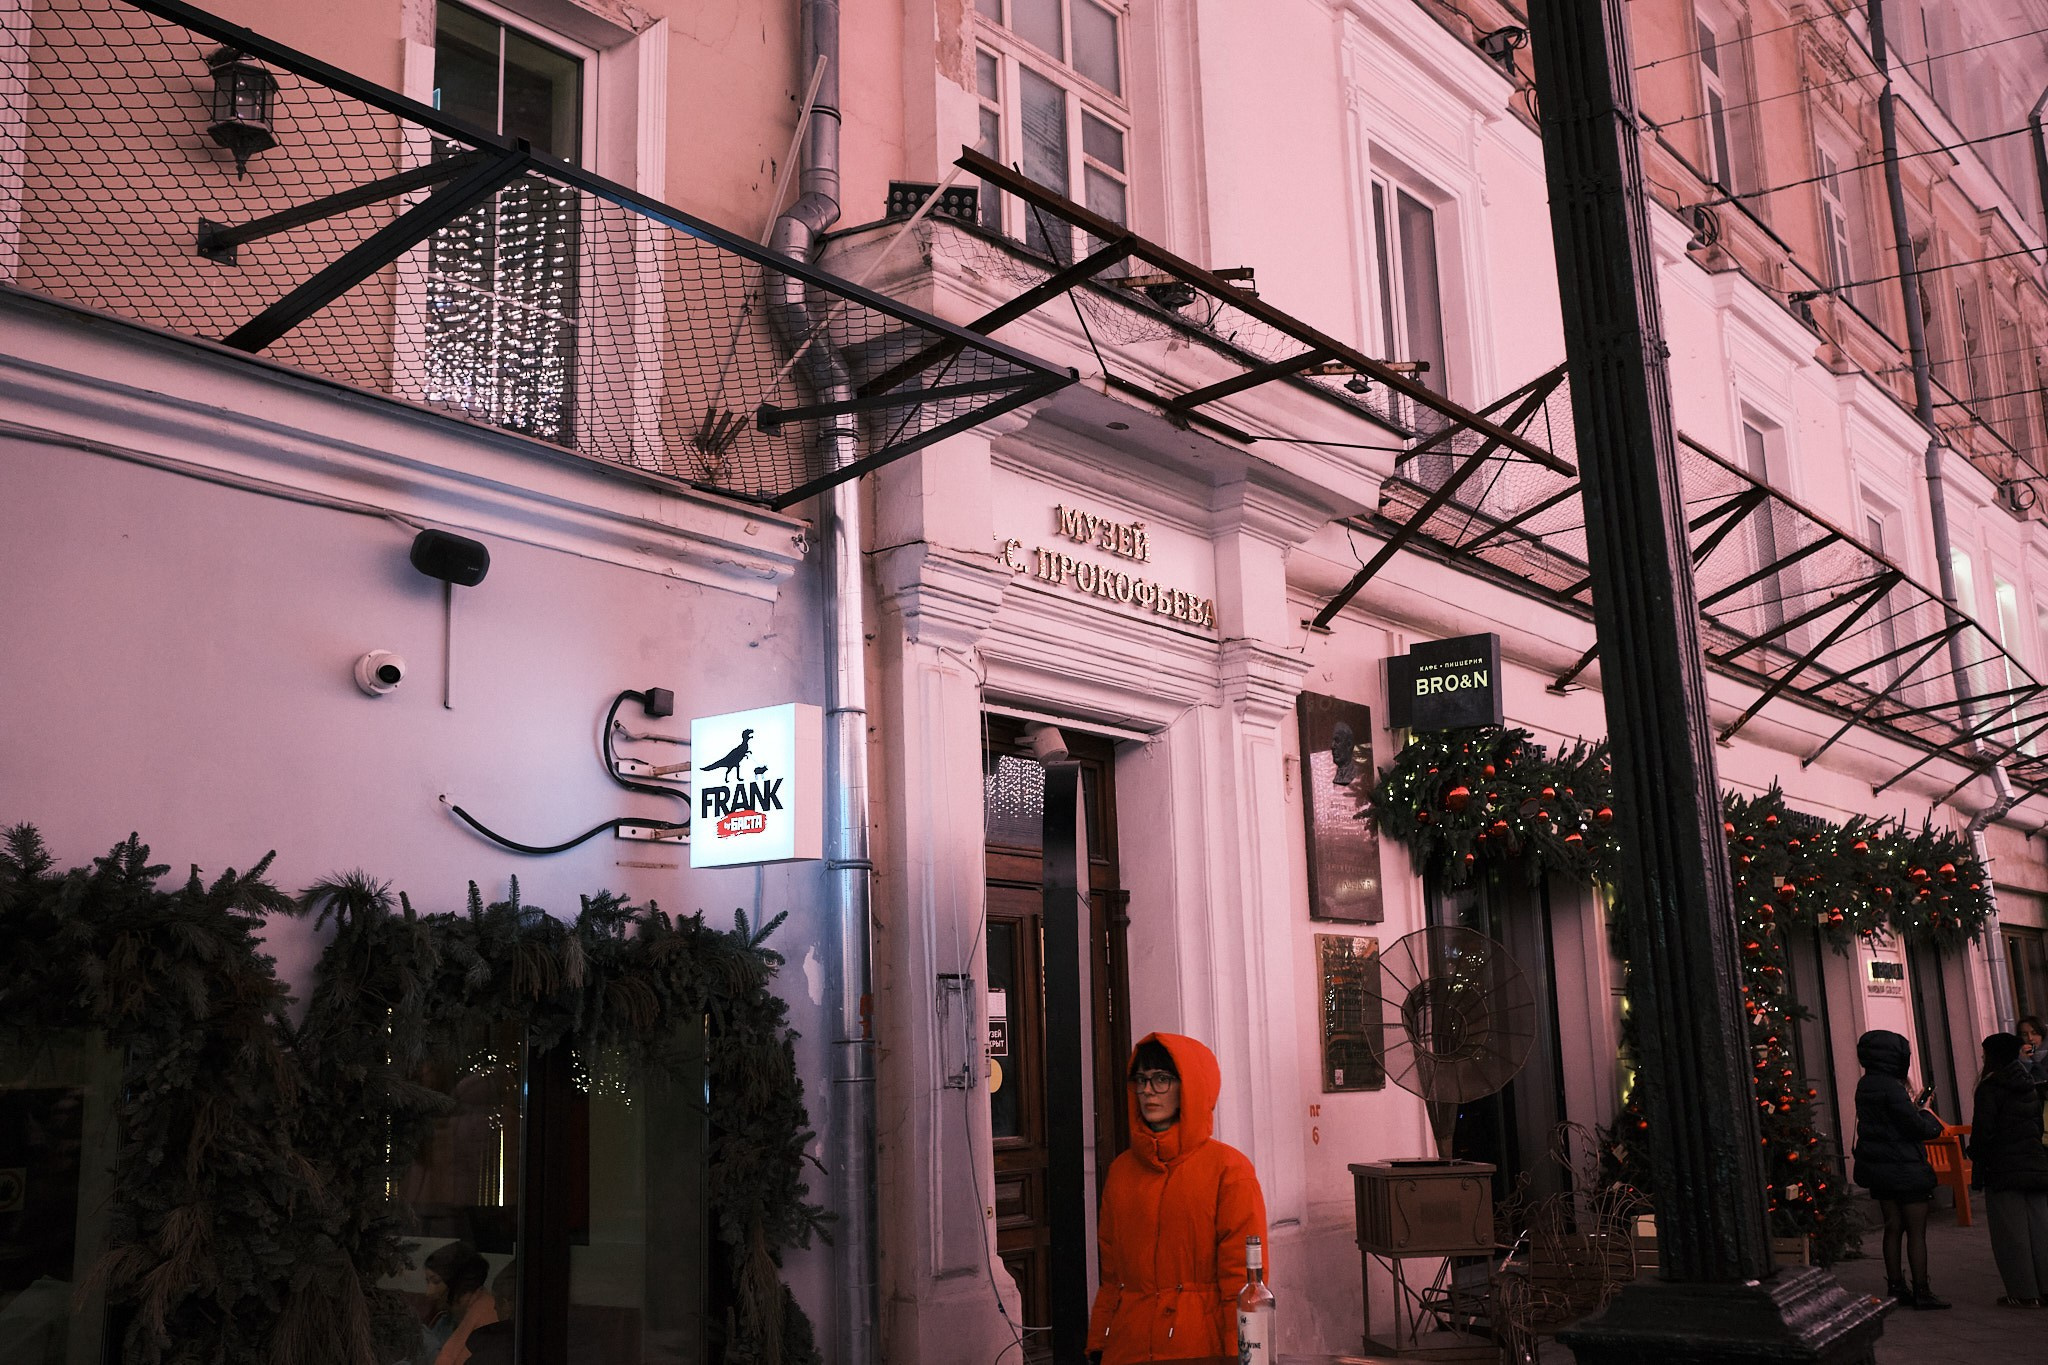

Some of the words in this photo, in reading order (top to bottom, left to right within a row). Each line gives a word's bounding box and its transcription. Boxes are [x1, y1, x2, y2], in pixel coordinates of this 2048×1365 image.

[1055, 503, 1151, 563] МУЗЕЙ
[1035, 546, 1219, 630] ПРОКОФЬЕВА
[1419, 664, 1438, 672] КАФЕ
[1444, 657, 1483, 668] ПИЦЦЕРИЯ
[1416, 670, 1488, 696] BRO&N
[702, 777, 784, 819] FRANK
[730, 815, 762, 832] БАСТА
[1312, 1126, 1320, 1145] 6
